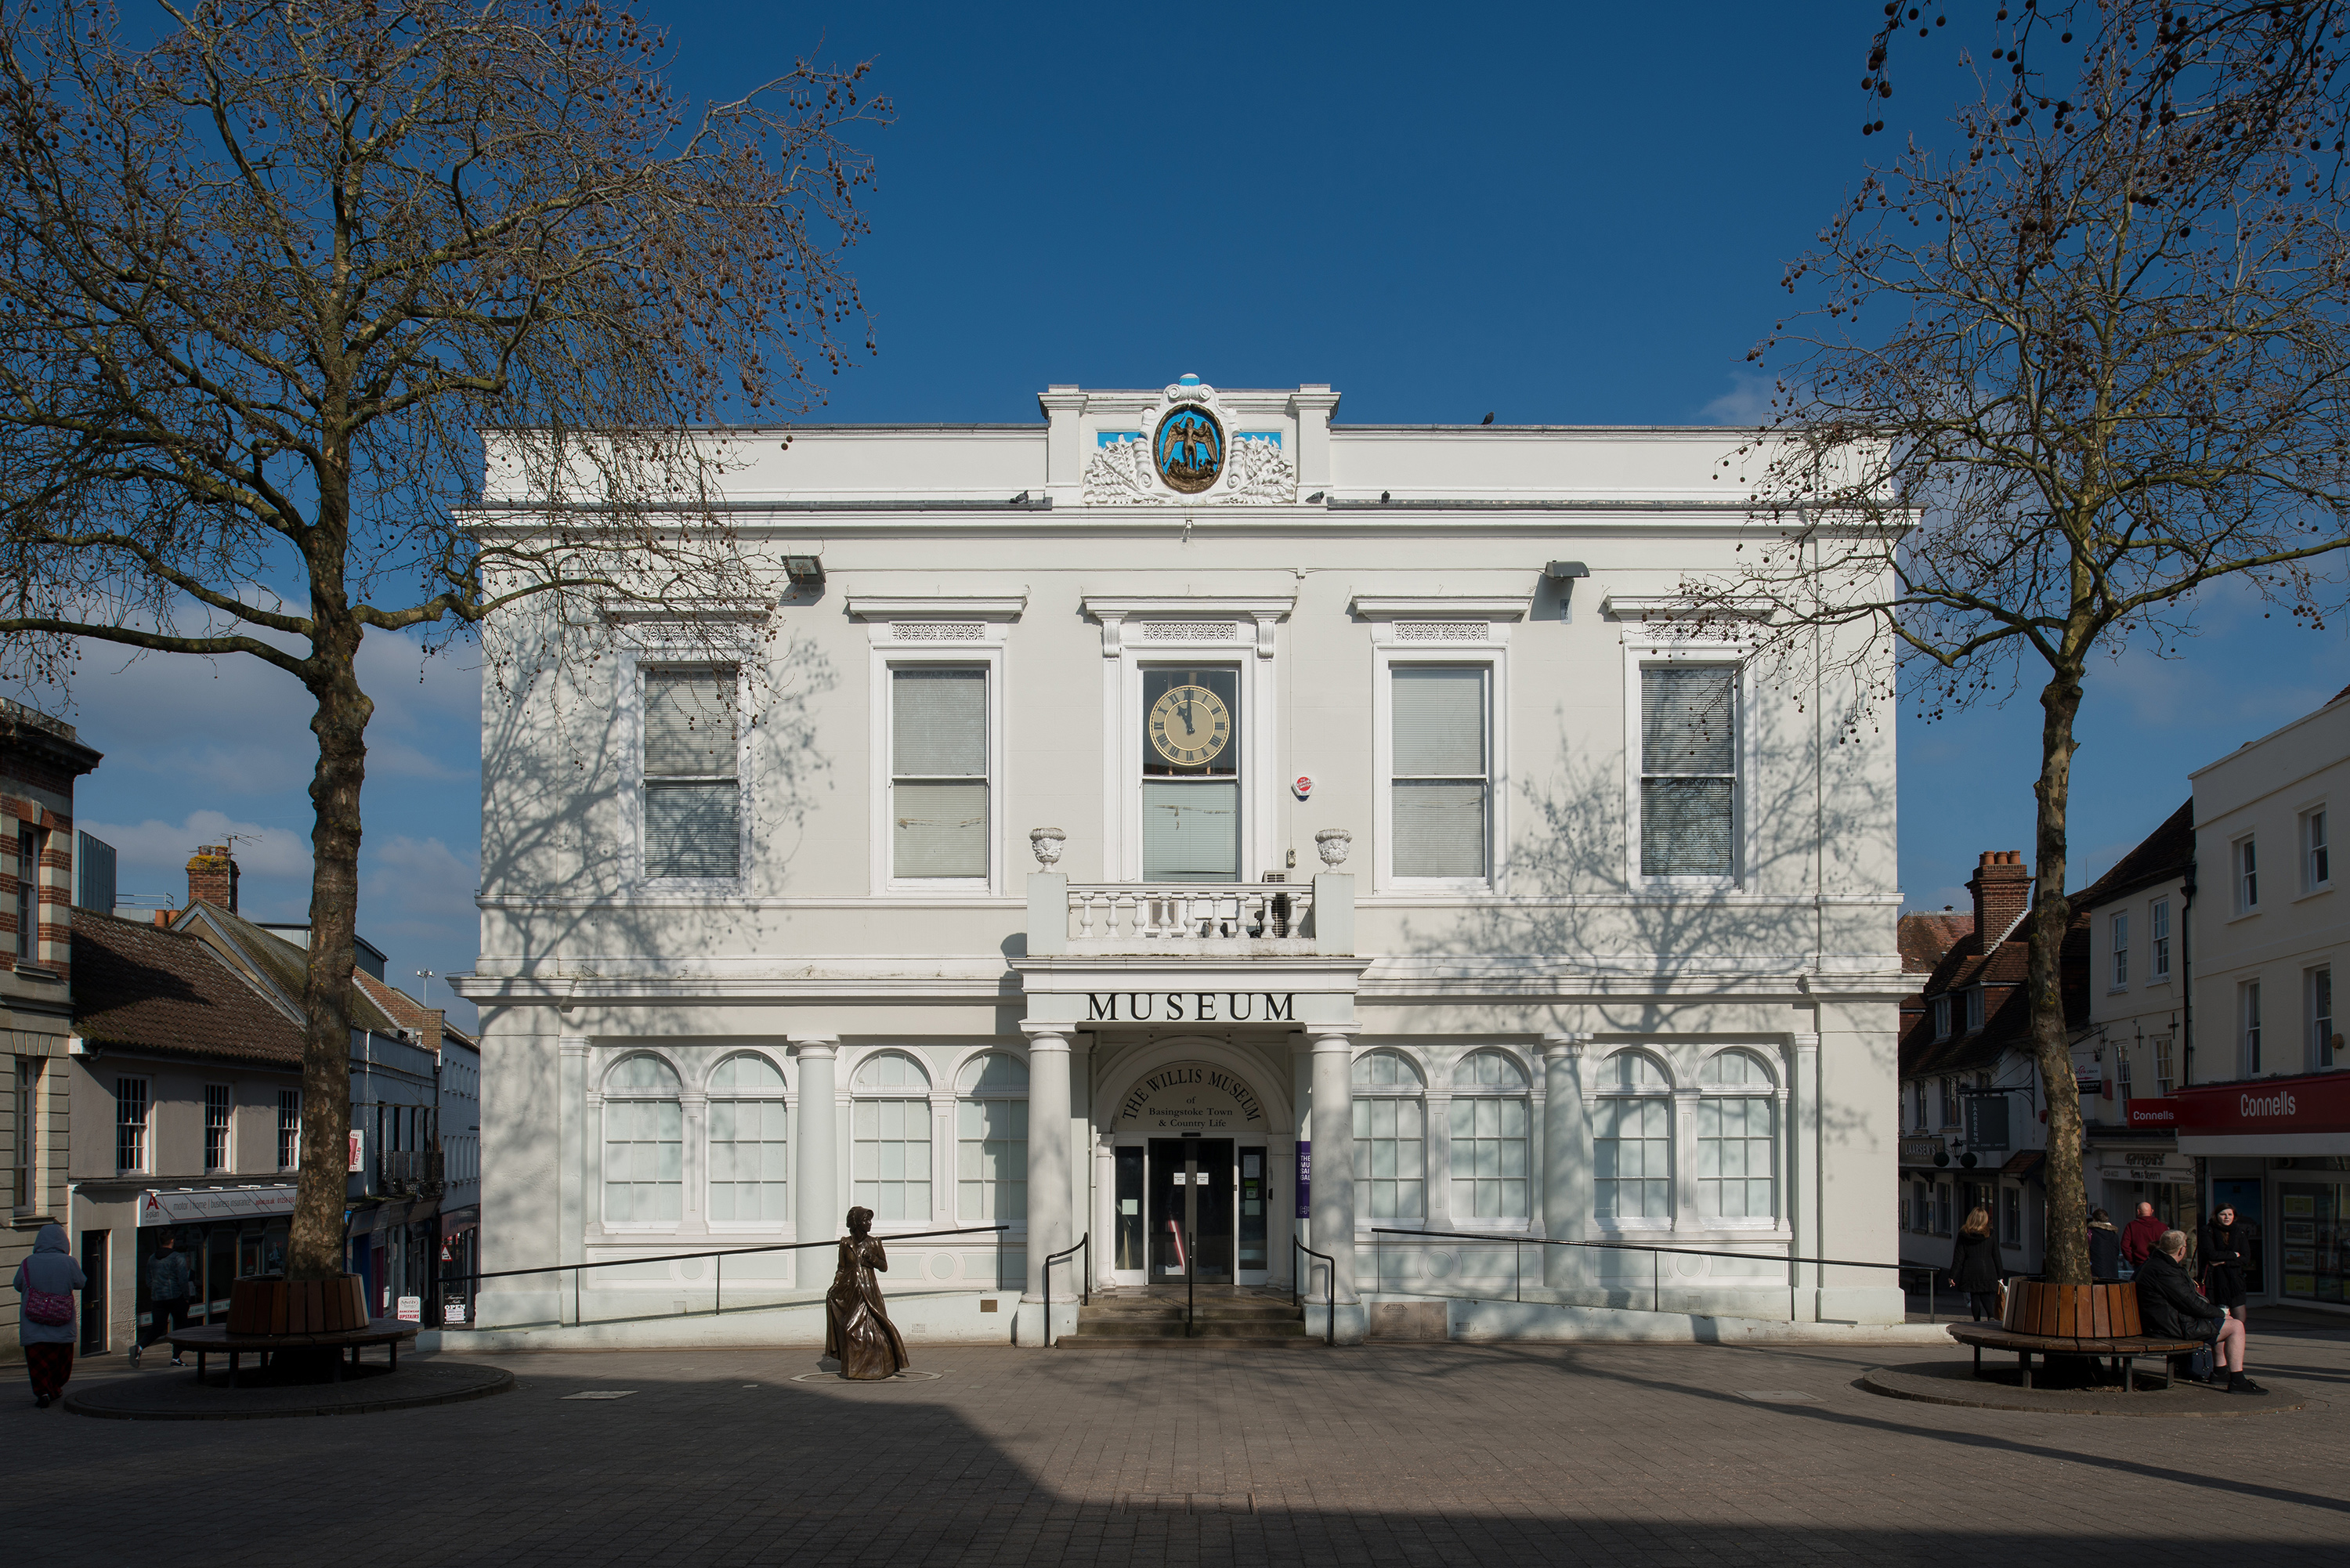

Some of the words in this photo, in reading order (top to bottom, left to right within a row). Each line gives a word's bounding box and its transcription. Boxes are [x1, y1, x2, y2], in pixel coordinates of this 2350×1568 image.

[1086, 992, 1296, 1021] MUSEUM
[1122, 1087, 1149, 1121] THE
[1146, 1068, 1202, 1093] WILLIS
[1208, 1071, 1261, 1122] MUSEUM
[1186, 1096, 1197, 1104] of
[2240, 1090, 2296, 1117] Connells
[1148, 1107, 1203, 1116] Basingstoke
[1207, 1107, 1233, 1116] Town
[2133, 1110, 2175, 1121] Connells
[1170, 1119, 1206, 1129] Country
[173, 1201, 189, 1211] motor
[193, 1200, 207, 1209] home
[211, 1198, 230, 1209] business
[230, 1198, 251, 1208] insurance
[145, 1210, 160, 1219] a-plan
